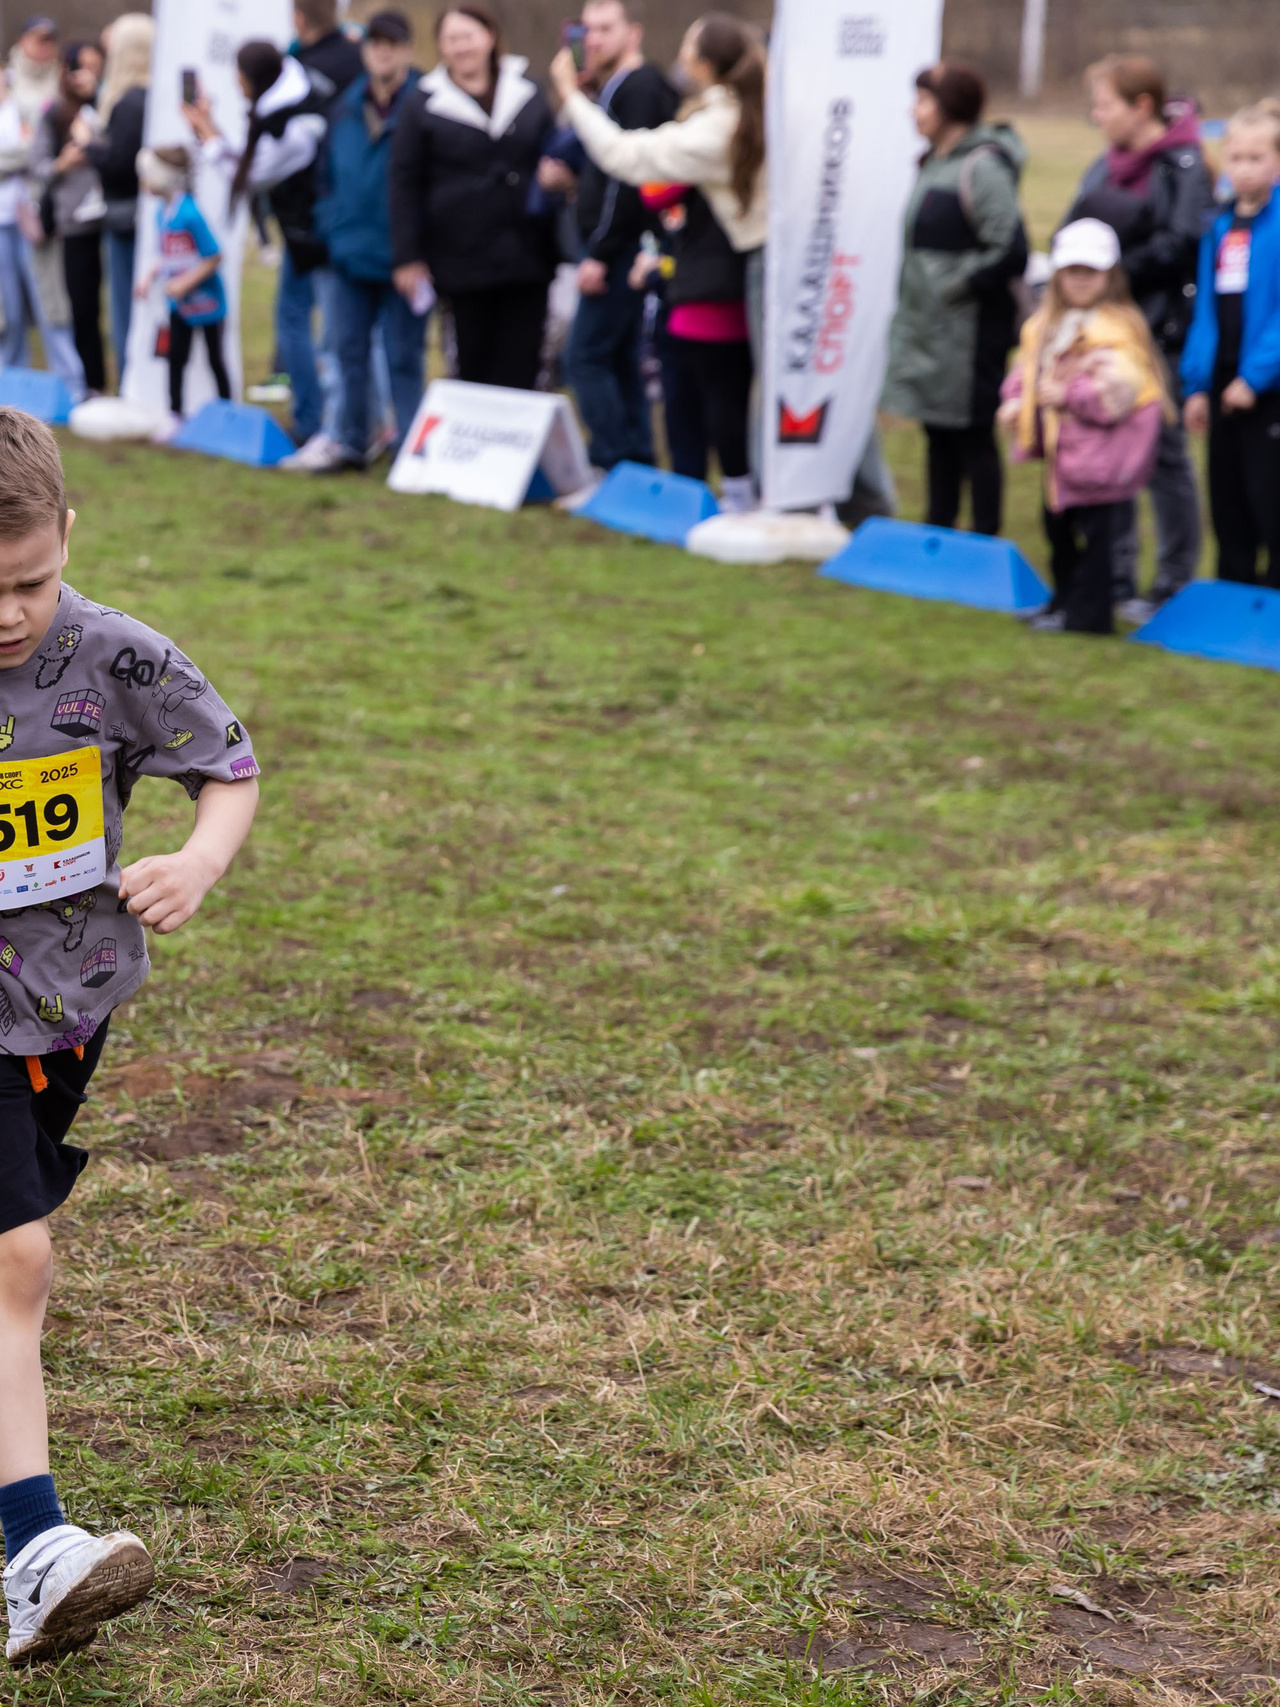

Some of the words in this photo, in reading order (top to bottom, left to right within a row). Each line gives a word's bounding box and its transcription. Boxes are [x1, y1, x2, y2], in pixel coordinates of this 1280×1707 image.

[787, 97, 852, 373] КАЛАШНИКОВ
[812, 250, 861, 375] СПОРТ
[5, 770, 22, 779] СПОРТ
[40, 762, 79, 783] 2025
